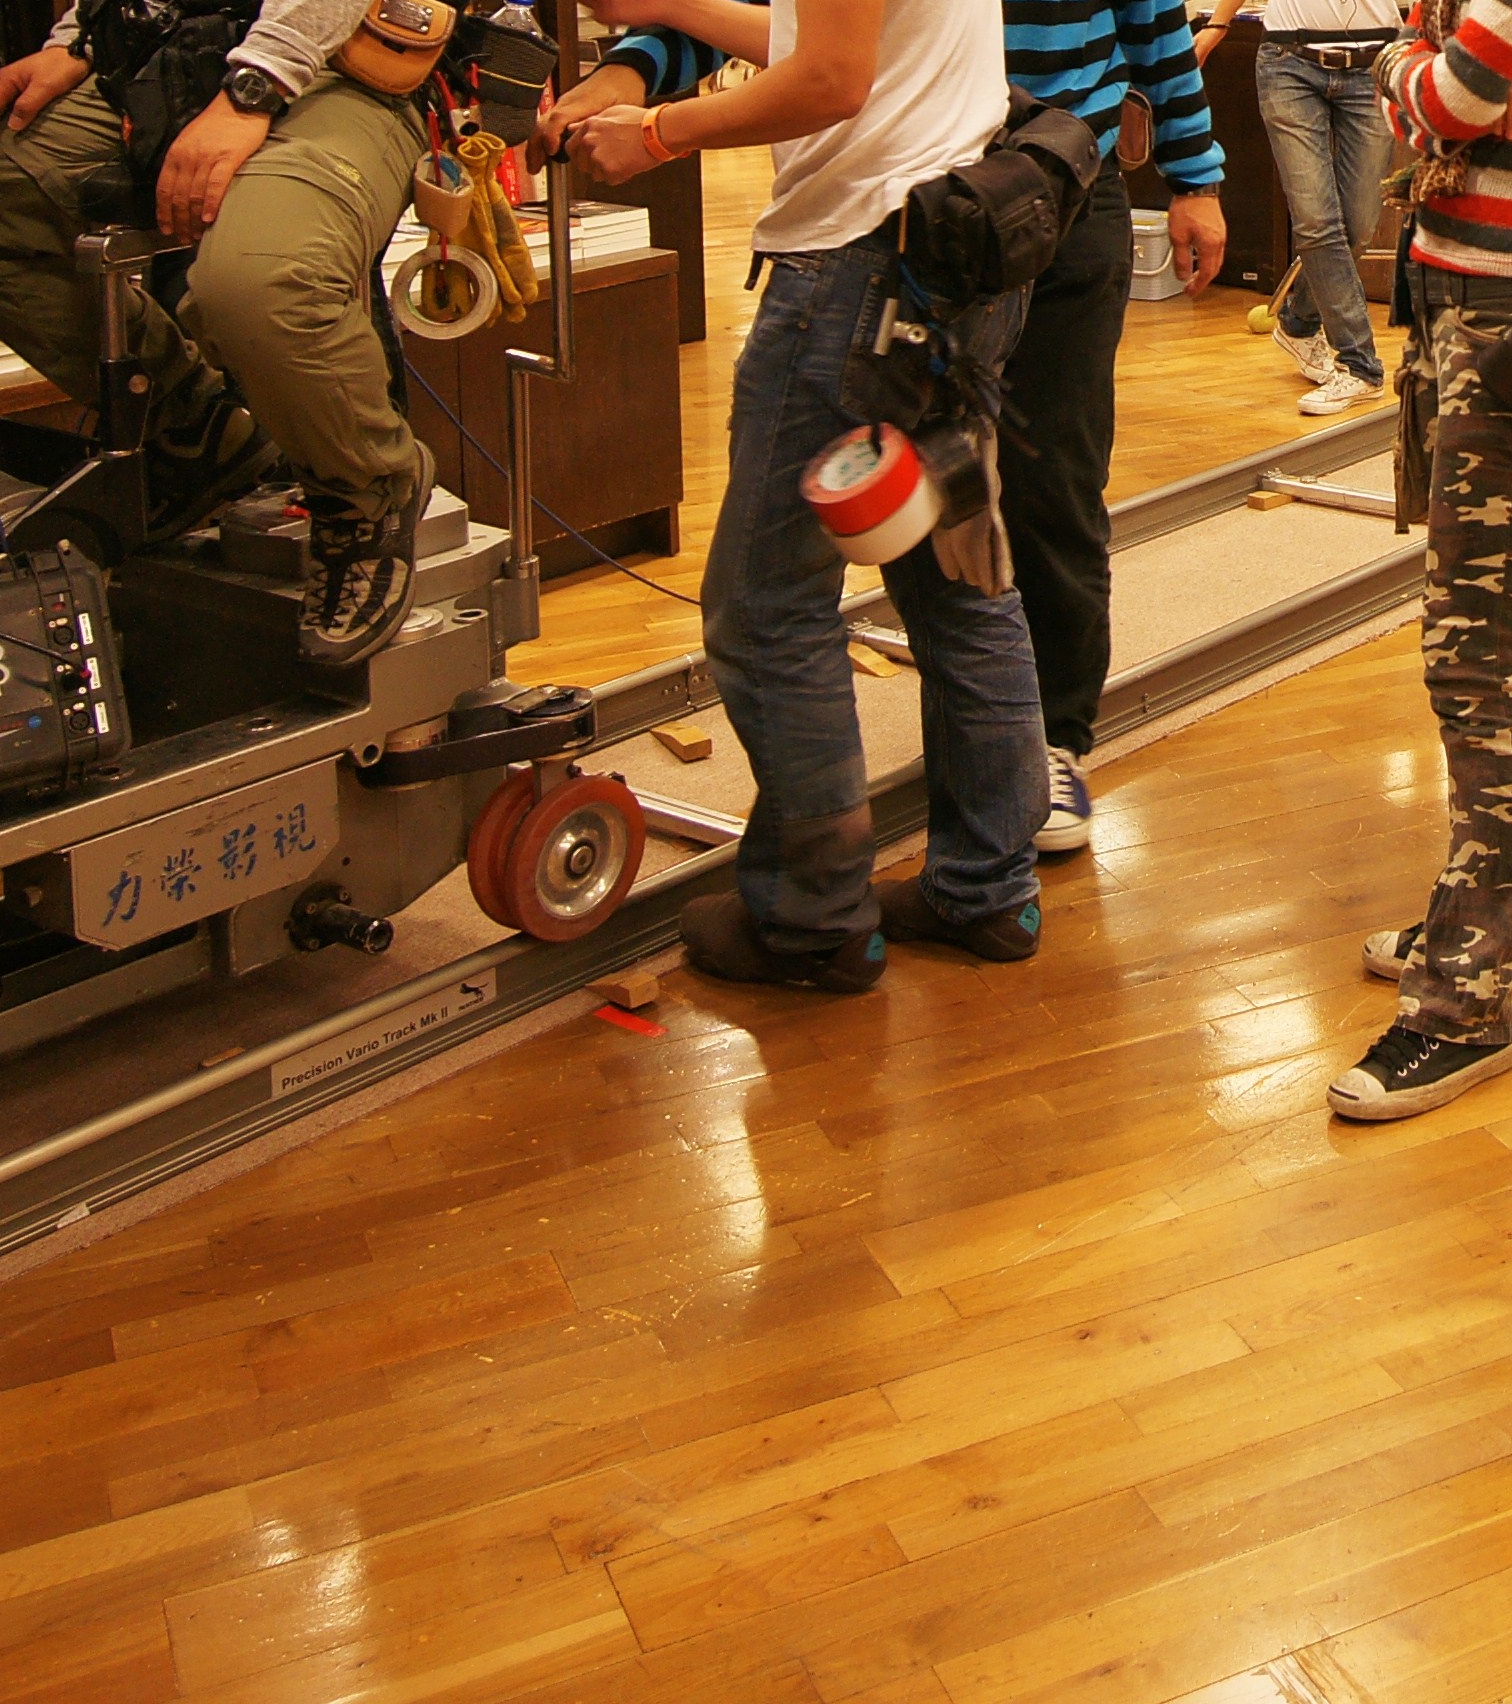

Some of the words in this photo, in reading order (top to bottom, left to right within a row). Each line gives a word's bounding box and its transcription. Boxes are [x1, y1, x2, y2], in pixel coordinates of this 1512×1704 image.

[103, 803, 316, 928] 力榮影視
[281, 1055, 343, 1090] Precision
[346, 1038, 380, 1061] Vario
[382, 1022, 416, 1045] Track
[420, 1011, 439, 1028] Mk
